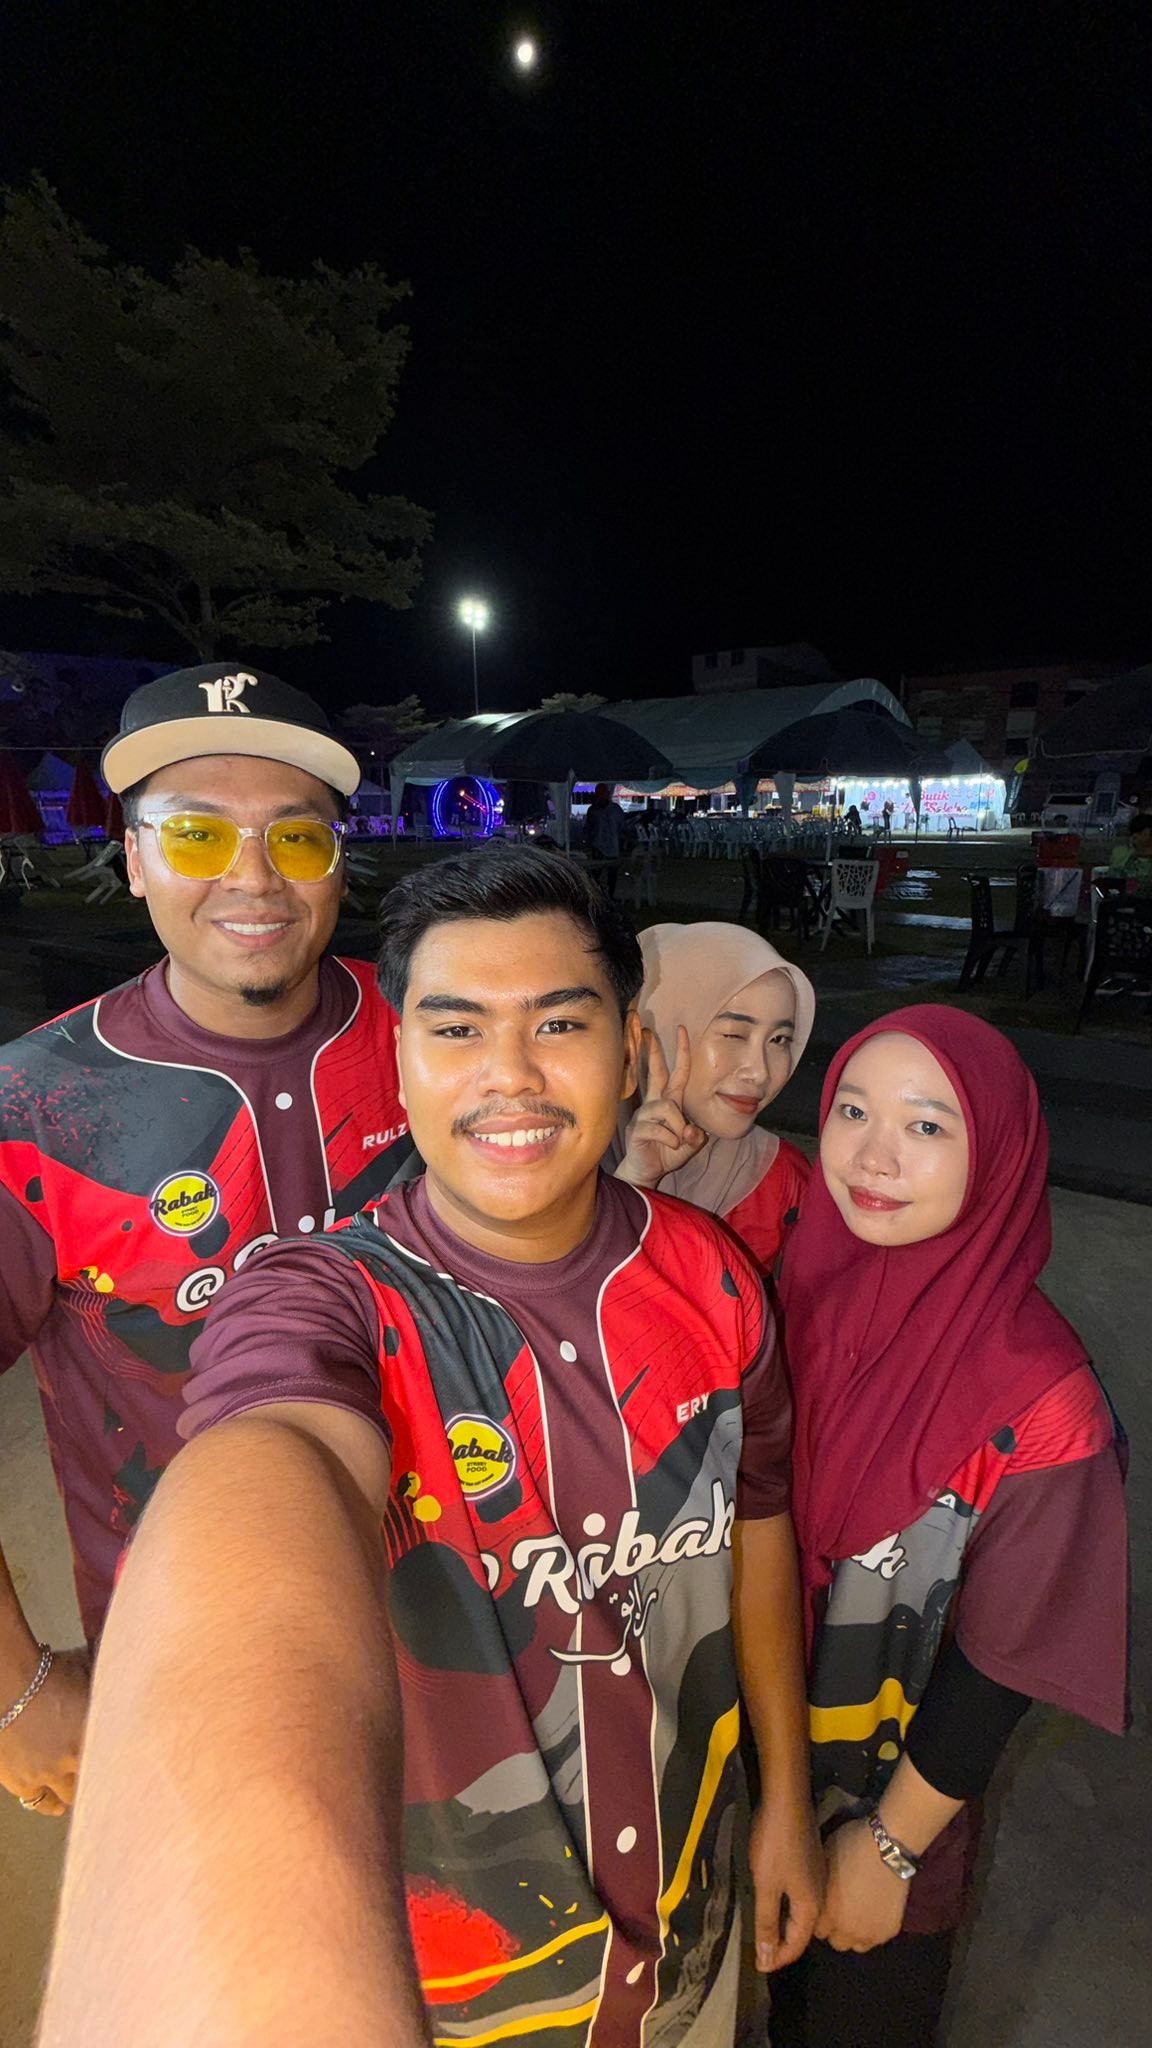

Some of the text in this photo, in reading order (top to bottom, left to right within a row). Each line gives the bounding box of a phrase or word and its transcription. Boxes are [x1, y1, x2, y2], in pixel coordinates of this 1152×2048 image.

[362, 1122, 407, 1150] RULZ
[149, 1182, 218, 1217] Rabak
[676, 1391, 710, 1424] ERY
